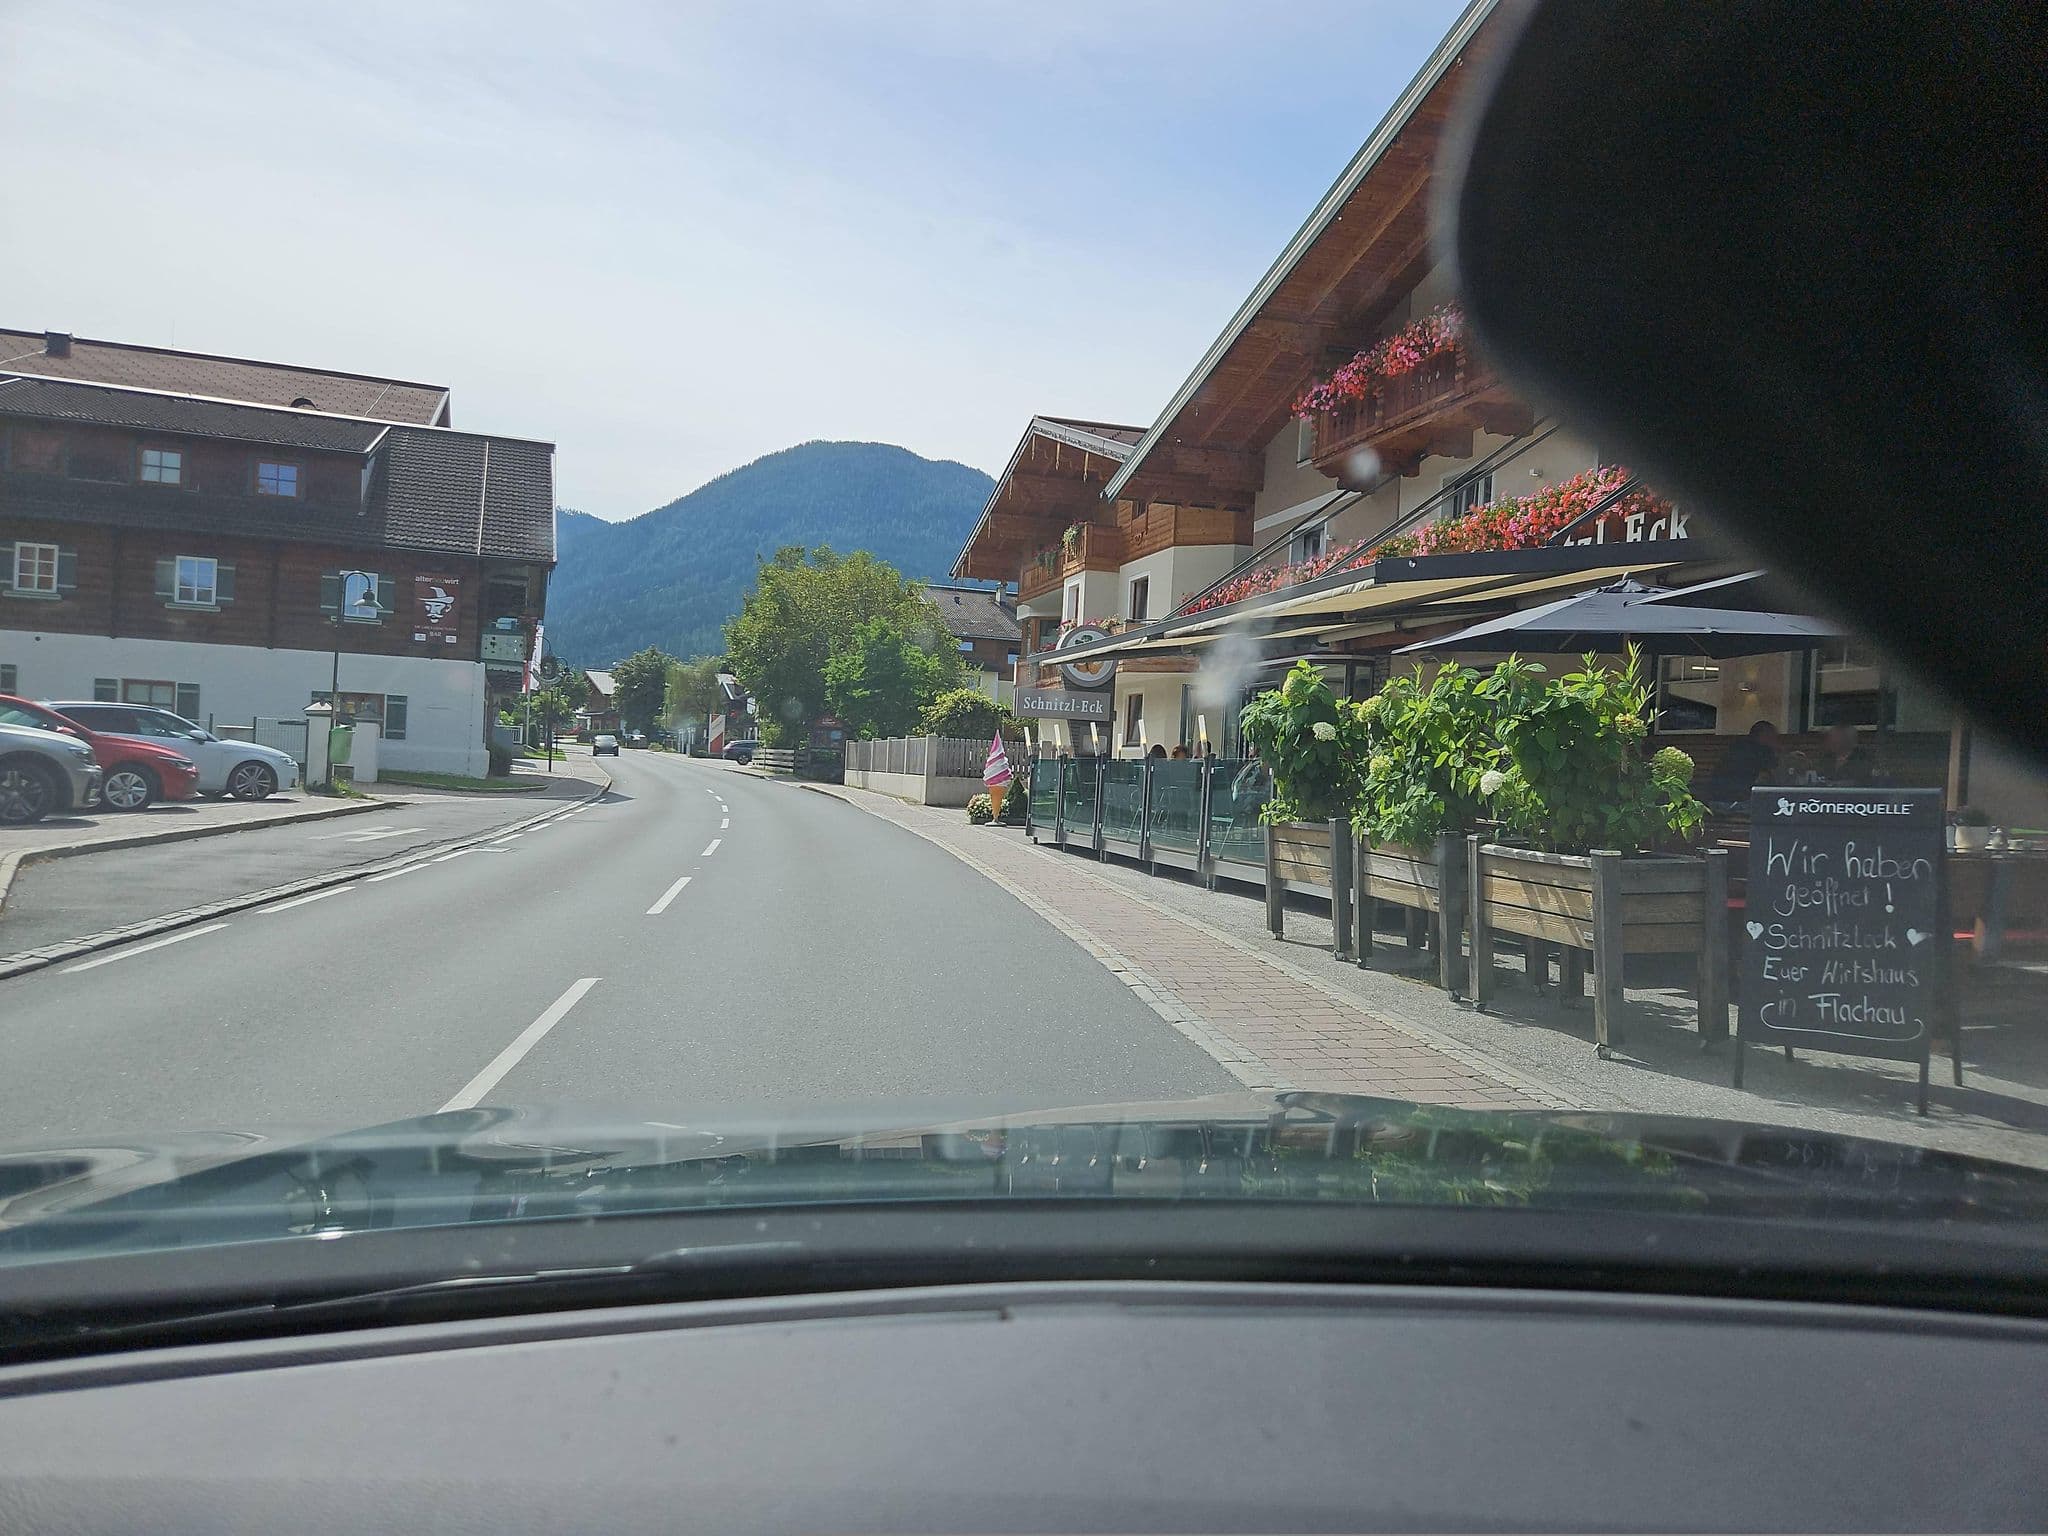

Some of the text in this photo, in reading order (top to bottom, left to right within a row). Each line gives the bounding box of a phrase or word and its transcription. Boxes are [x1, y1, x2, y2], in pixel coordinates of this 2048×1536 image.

[1023, 696, 1103, 714] Schnitzl-Eck
[1766, 836, 1932, 880] Wir haben
[1773, 877, 1869, 917] geöffnet
[1763, 955, 1920, 988] Euer Wirtshaus
[1777, 989, 1905, 1025] in Flachau
